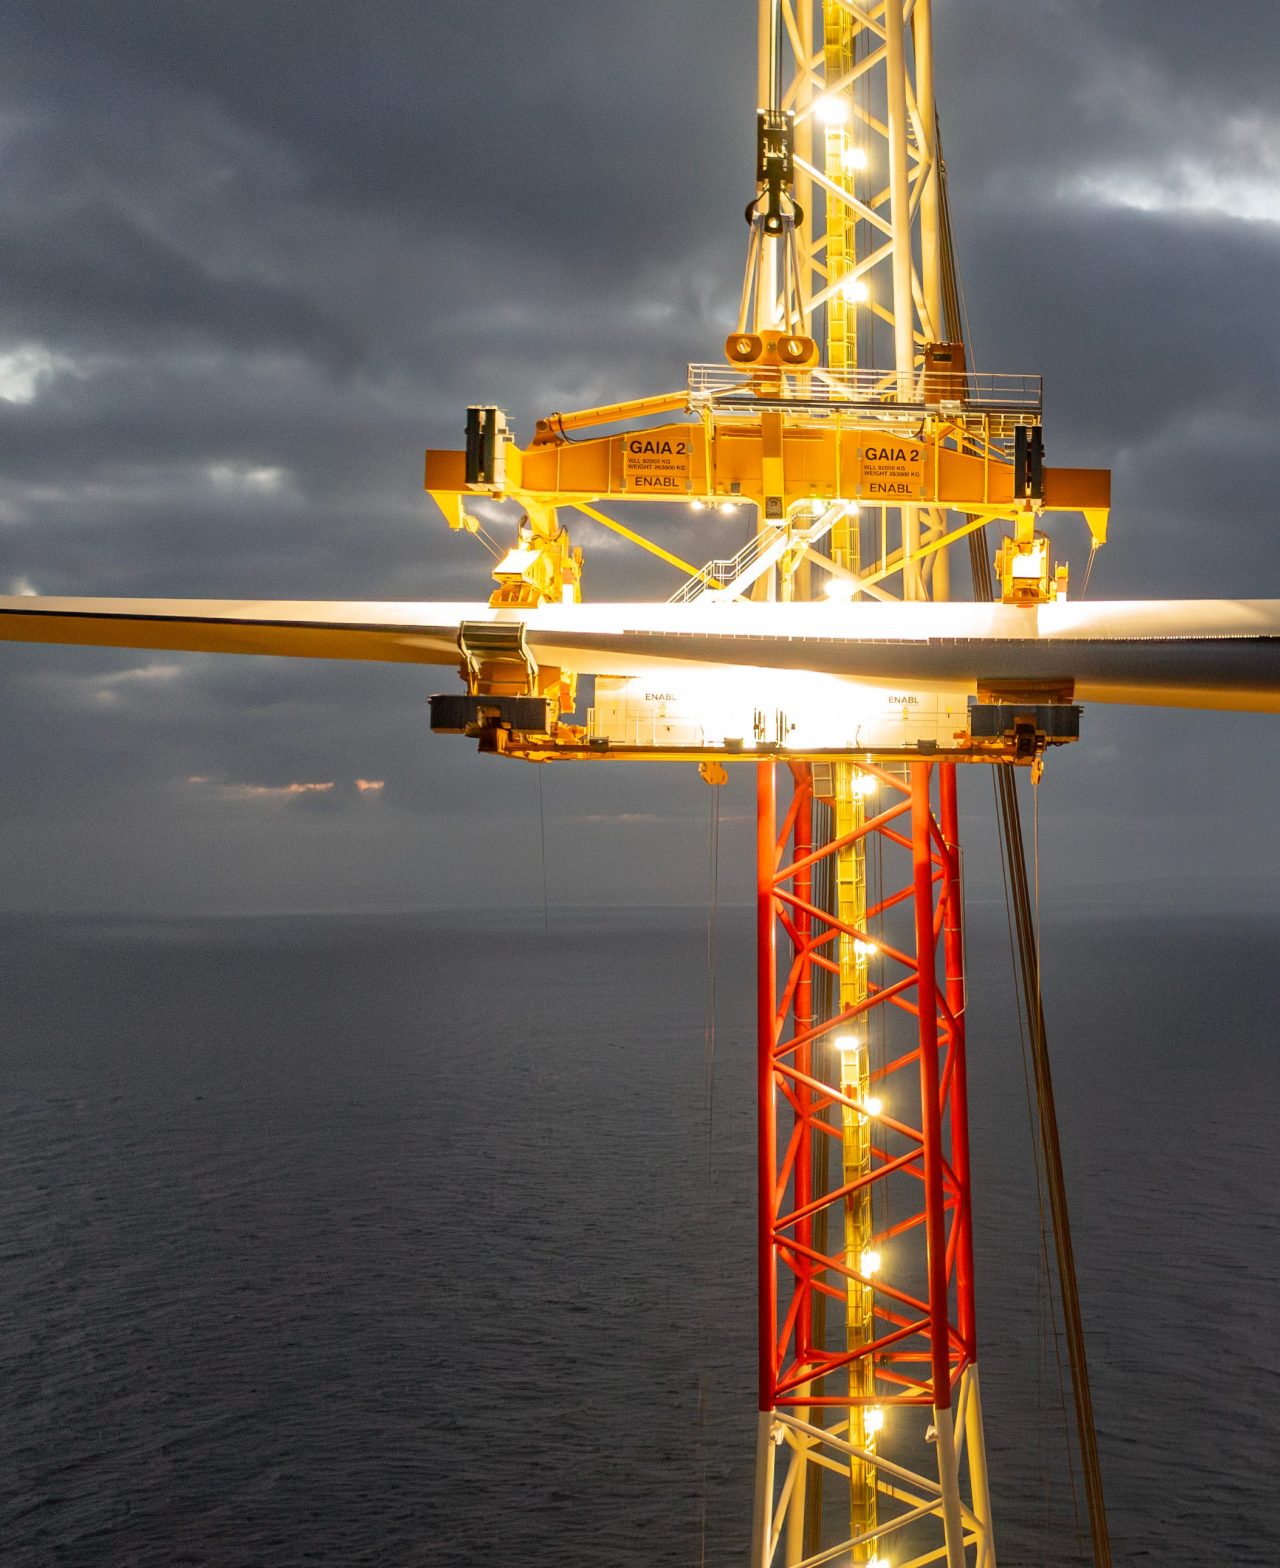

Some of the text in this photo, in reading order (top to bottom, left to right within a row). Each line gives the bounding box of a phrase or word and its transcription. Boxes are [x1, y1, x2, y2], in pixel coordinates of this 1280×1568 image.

[630, 441, 686, 455] GAIA 2
[865, 448, 919, 462] GAIA 2
[635, 477, 679, 487] ENABL
[870, 483, 912, 493] ENABL
[645, 693, 677, 701] ENABL
[888, 696, 919, 704] ENABL
